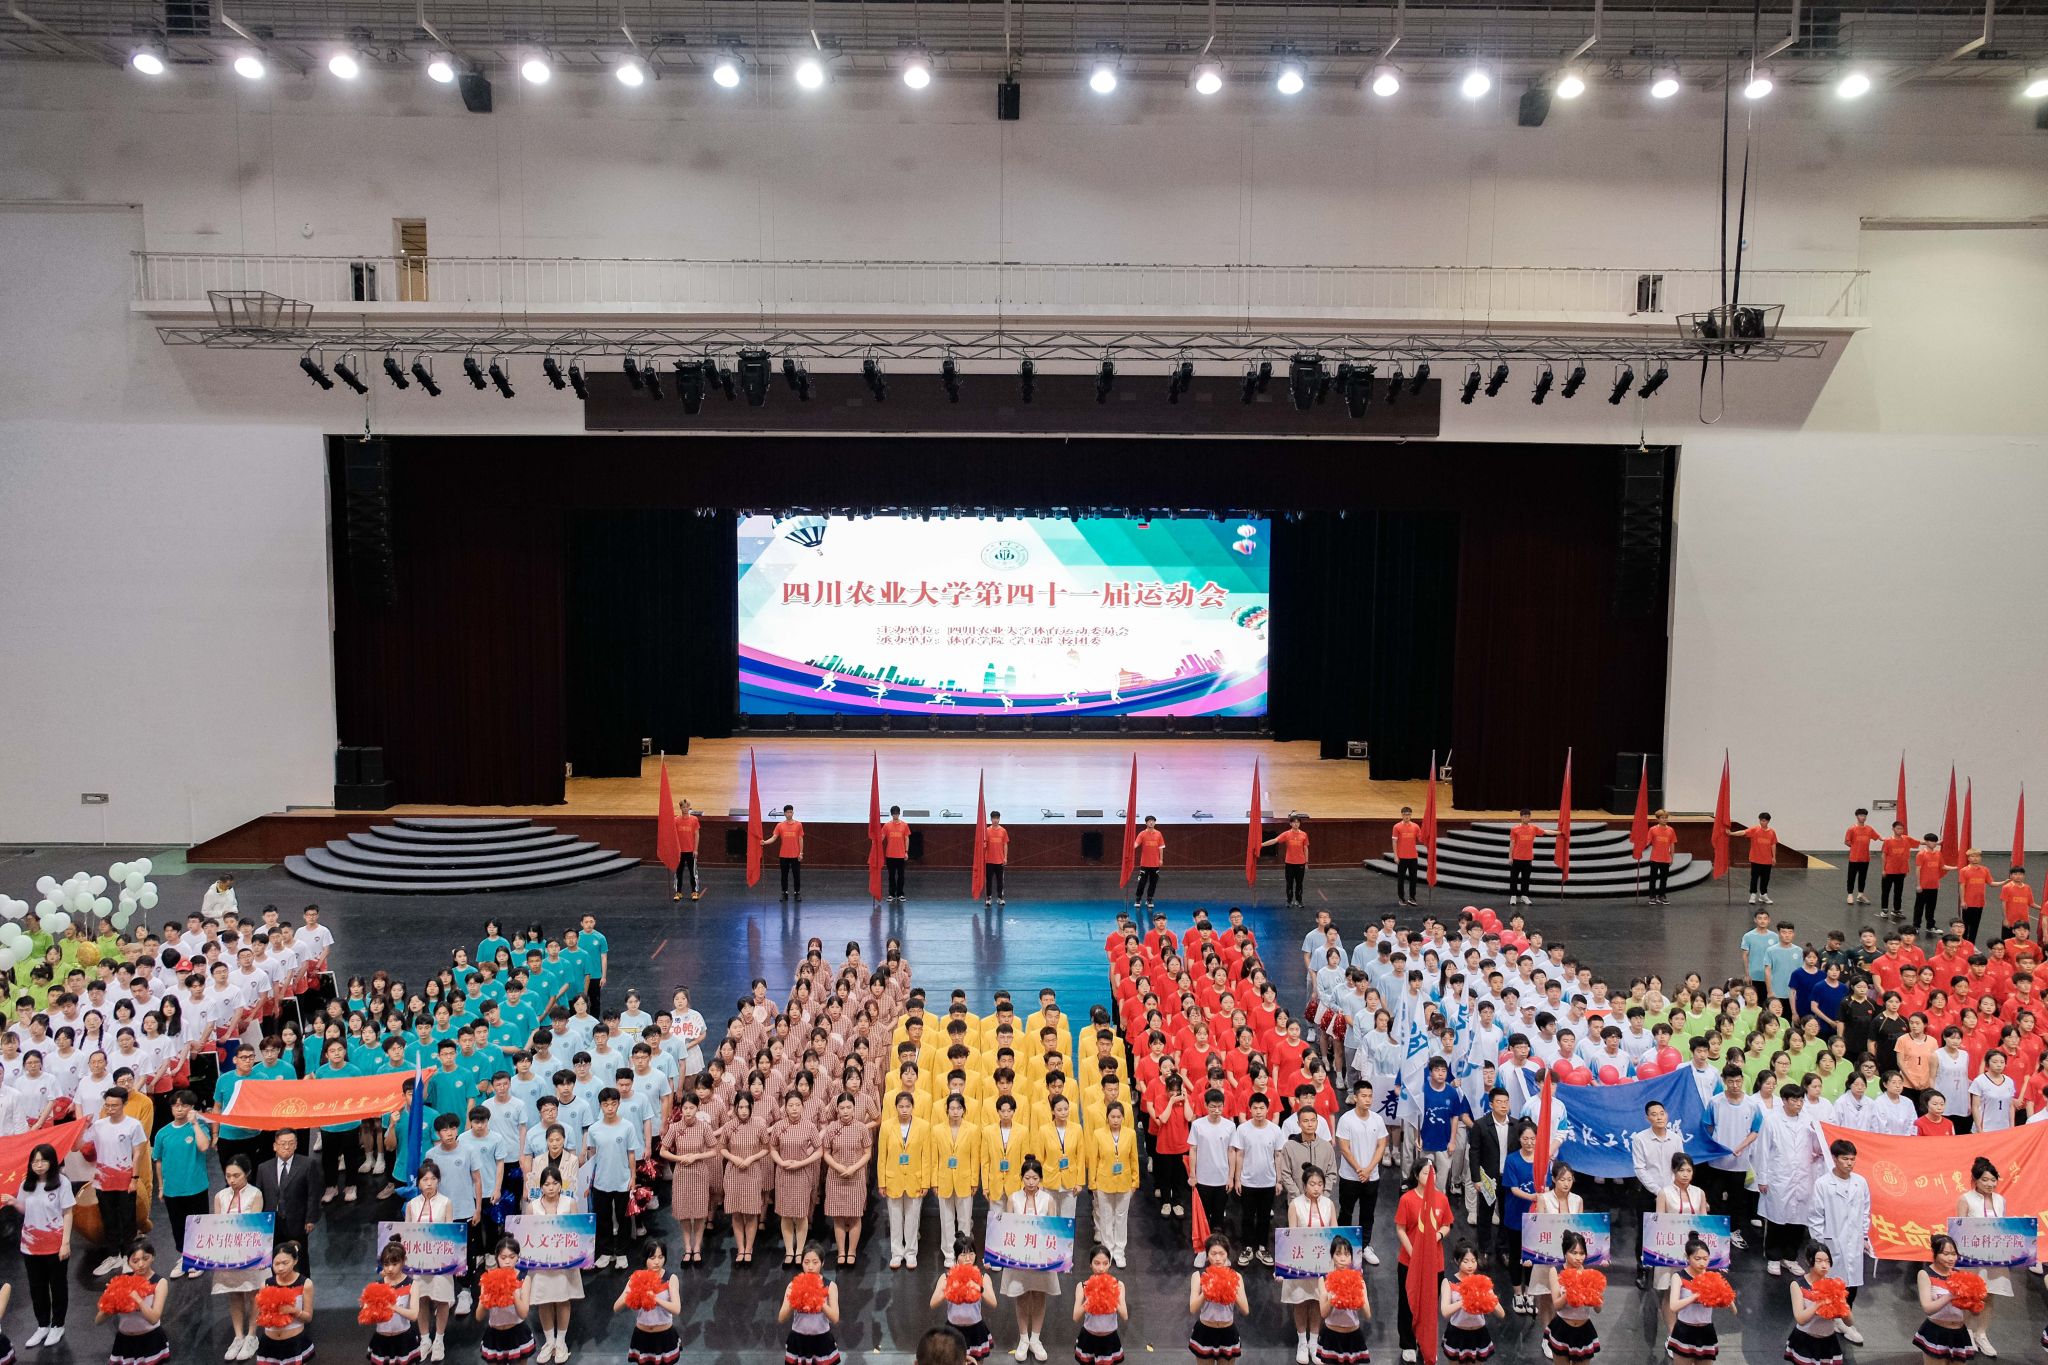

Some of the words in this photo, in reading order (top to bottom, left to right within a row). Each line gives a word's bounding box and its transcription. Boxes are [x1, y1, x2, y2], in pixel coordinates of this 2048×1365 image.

[782, 580, 1227, 607] 四川农业大学第四十一届运动会
[196, 1232, 262, 1249] 艺术与传媒学院
[522, 1233, 579, 1249] 人文学院
[1004, 1232, 1057, 1250] 裁判员
[1539, 1231, 1594, 1245] 理院
[1961, 1234, 2024, 1248] 生命科学学院
[402, 1241, 454, 1255] 利水电学院
[1292, 1245, 1326, 1260] 法学
